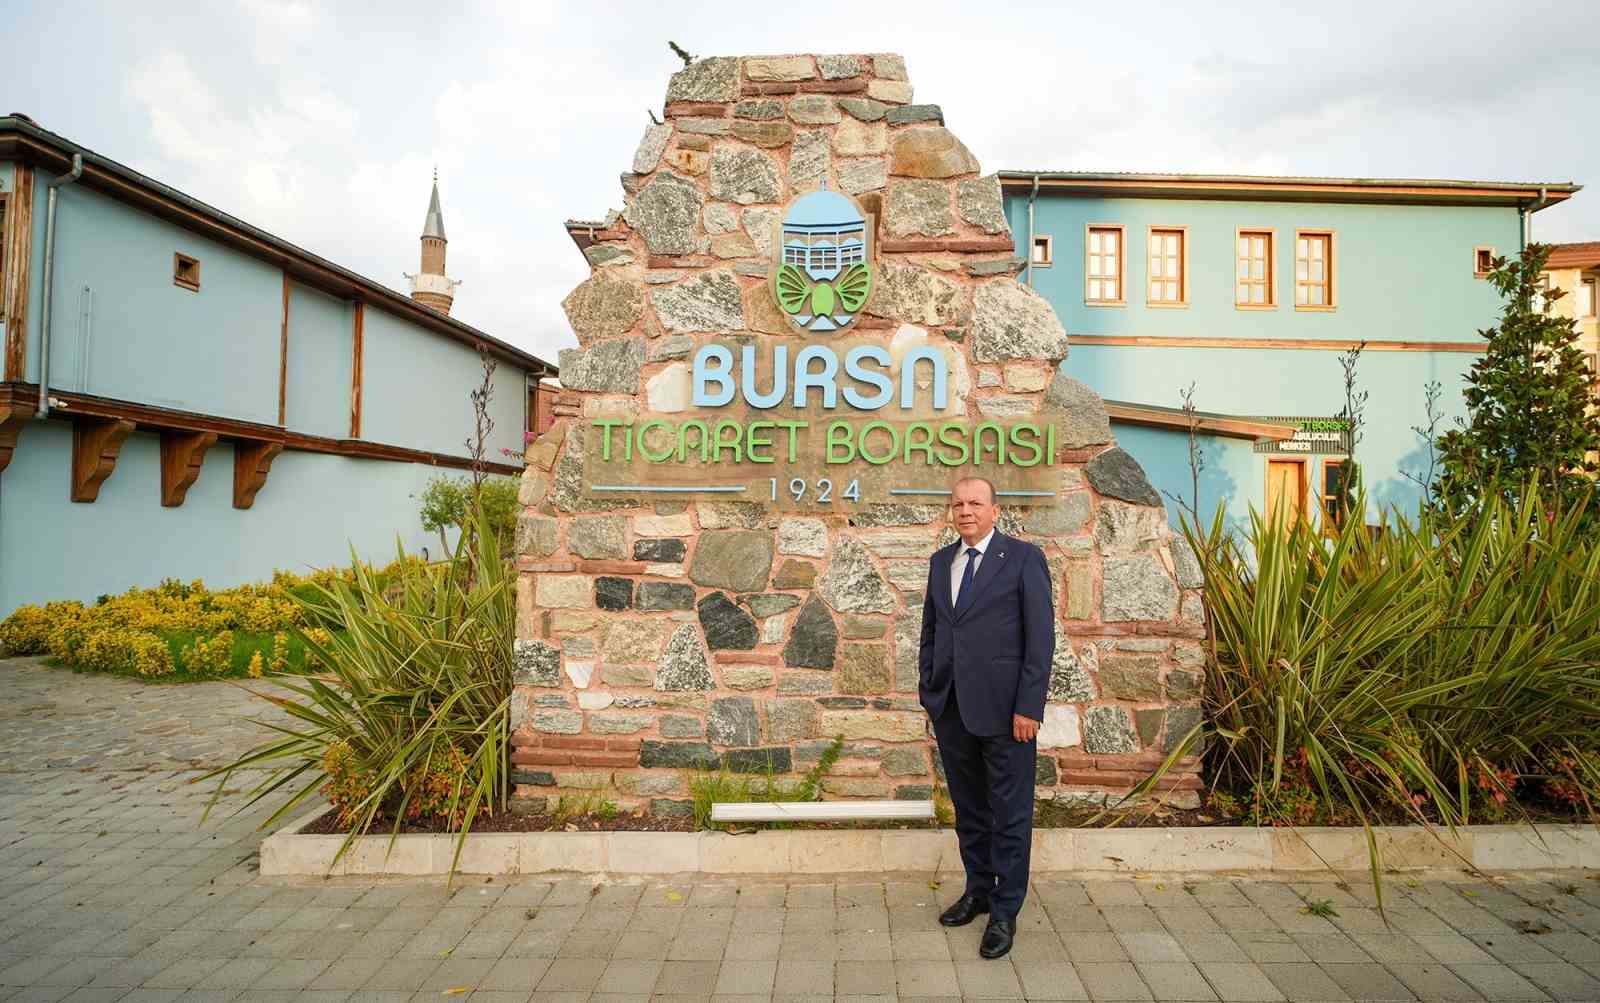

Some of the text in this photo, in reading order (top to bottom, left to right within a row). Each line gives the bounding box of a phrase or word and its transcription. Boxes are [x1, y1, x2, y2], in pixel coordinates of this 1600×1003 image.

[692, 344, 947, 409] BURSA
[826, 420, 1056, 467] BORSASI
[769, 477, 861, 503] 1924
